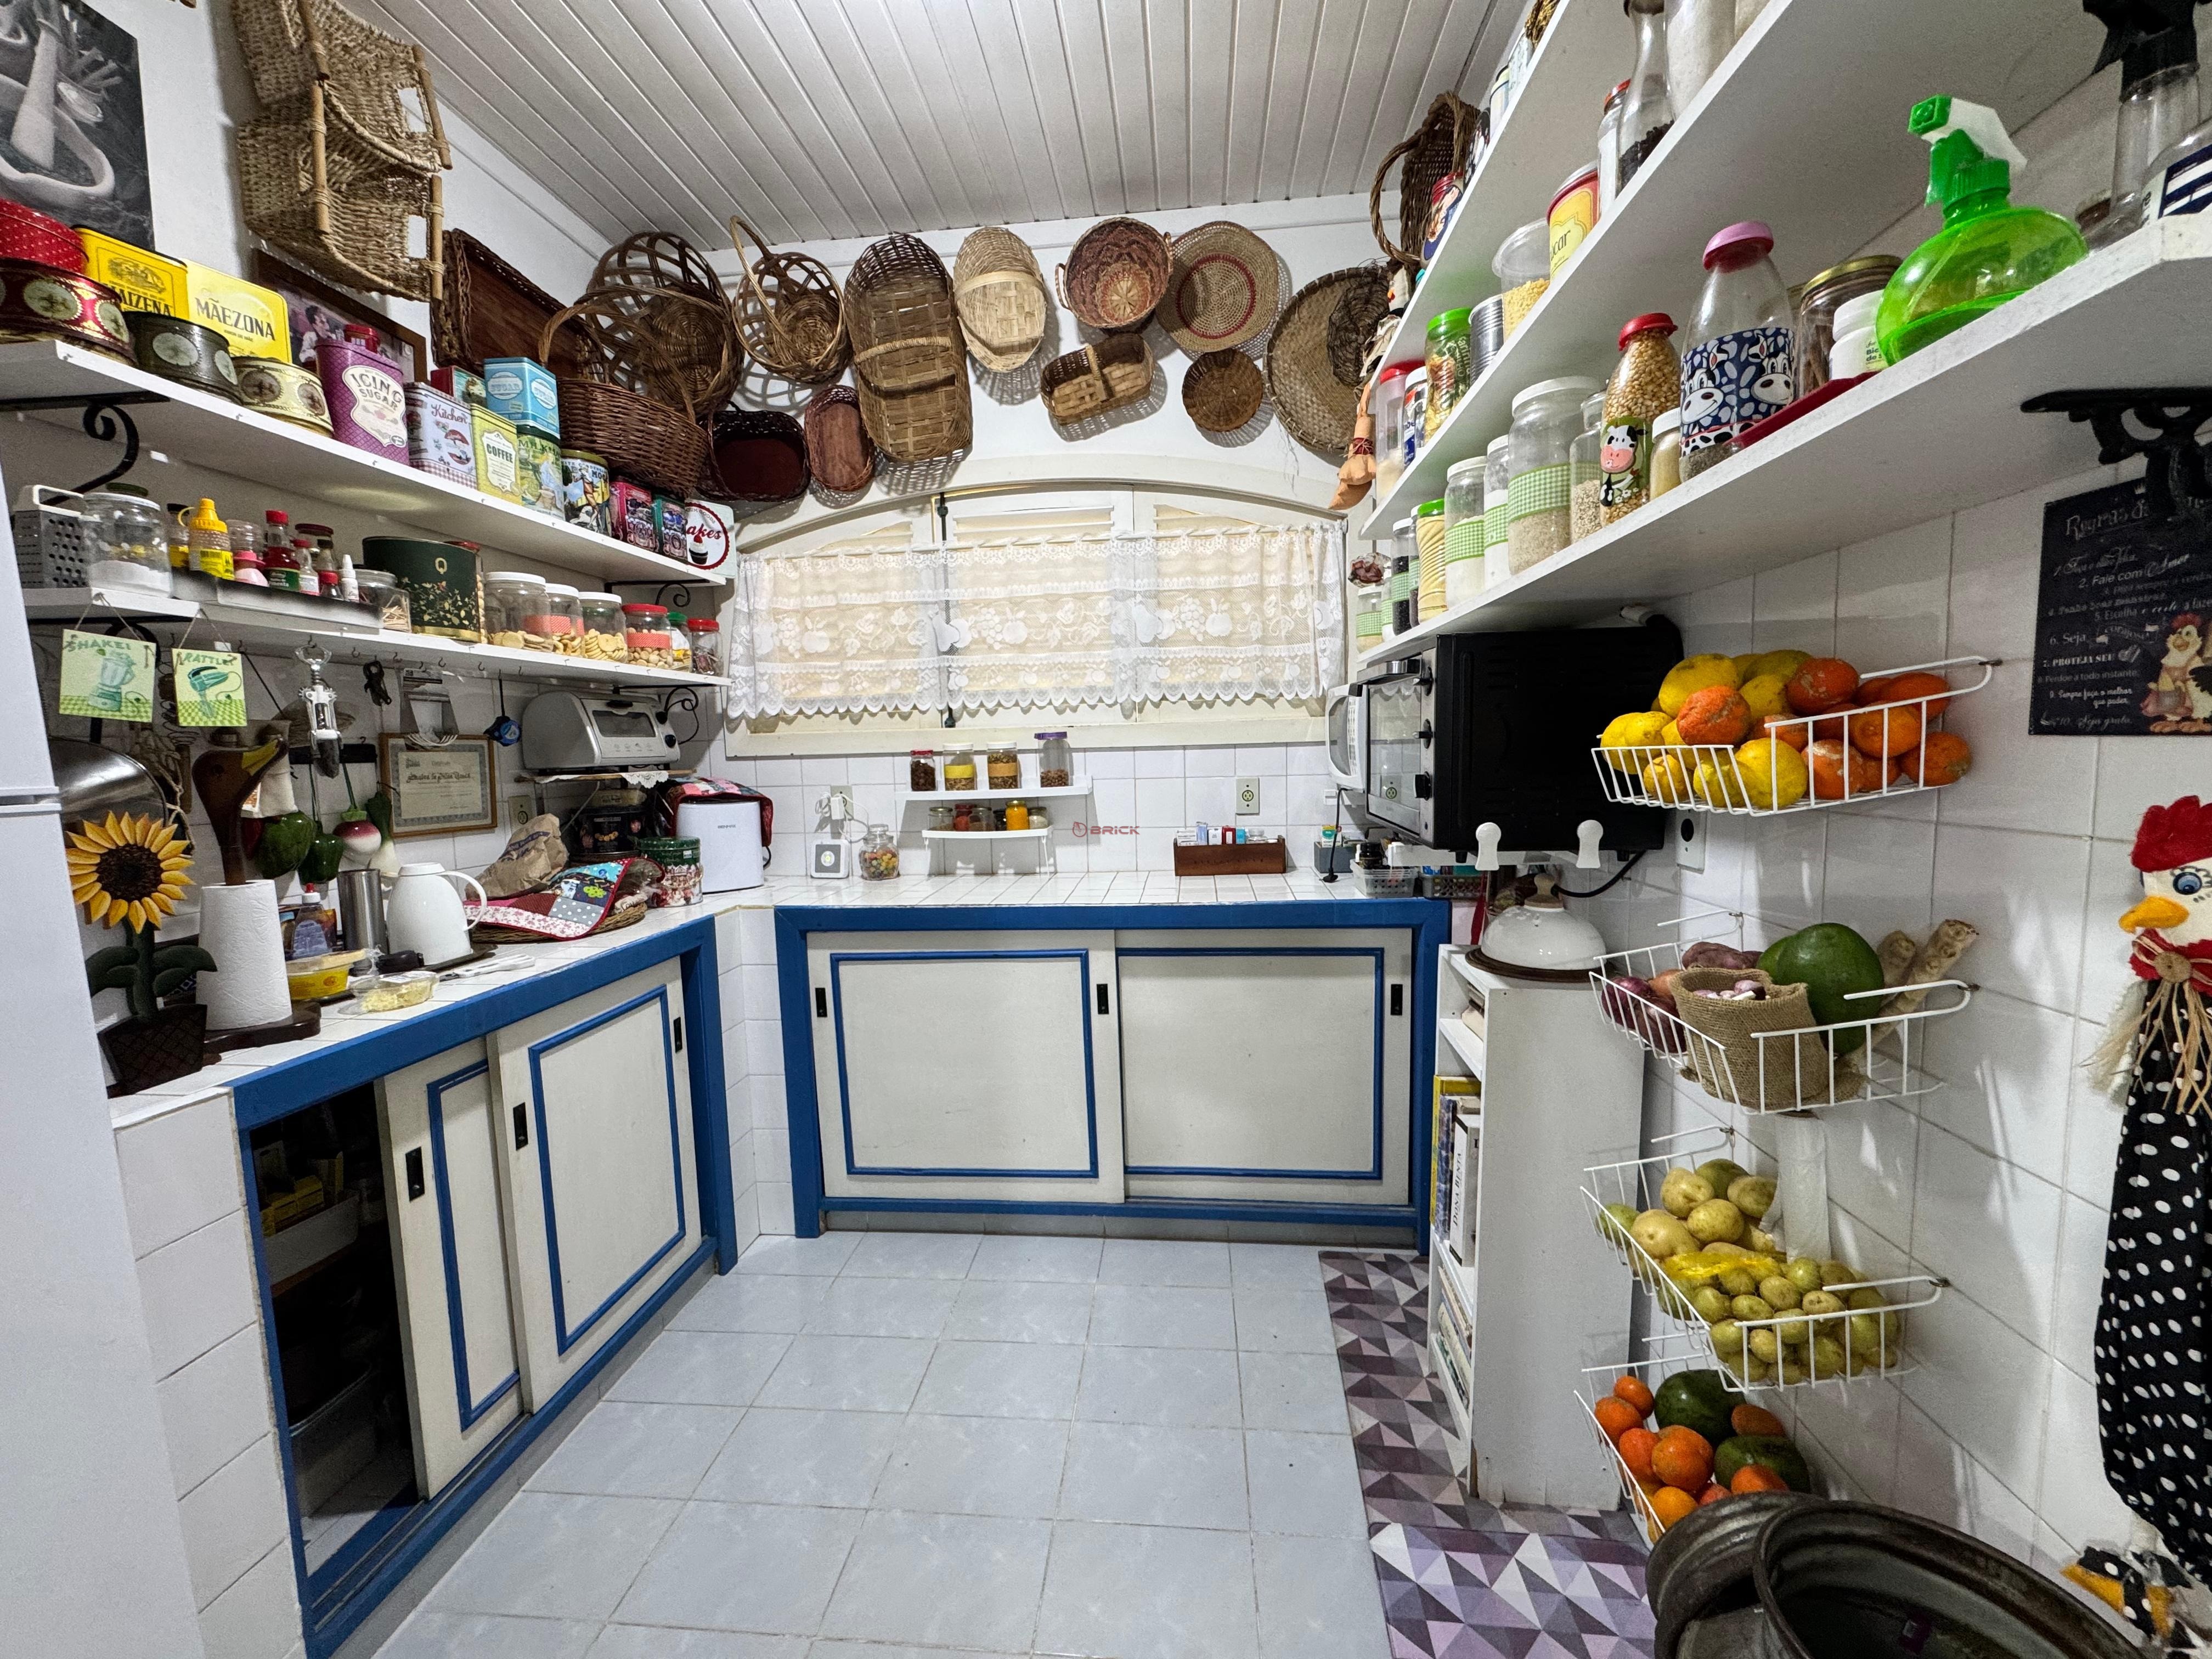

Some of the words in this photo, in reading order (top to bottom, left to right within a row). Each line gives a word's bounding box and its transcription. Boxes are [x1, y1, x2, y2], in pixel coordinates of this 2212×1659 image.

[111, 285, 173, 317] AIZENA
[195, 297, 275, 341] MÃEZONA
[350, 373, 403, 404] ICING
[359, 388, 398, 410] SUGAR
[431, 404, 468, 425] Kitchen
[486, 443, 514, 464] COFFEE
[686, 523, 722, 540] akes
[2092, 574, 2115, 586] Fale
[2117, 569, 2143, 582] com
[2063, 631, 2086, 646] Seja
[2052, 656, 2094, 667] PROTEJA
[1454, 1153, 1463, 1188] BENTA
